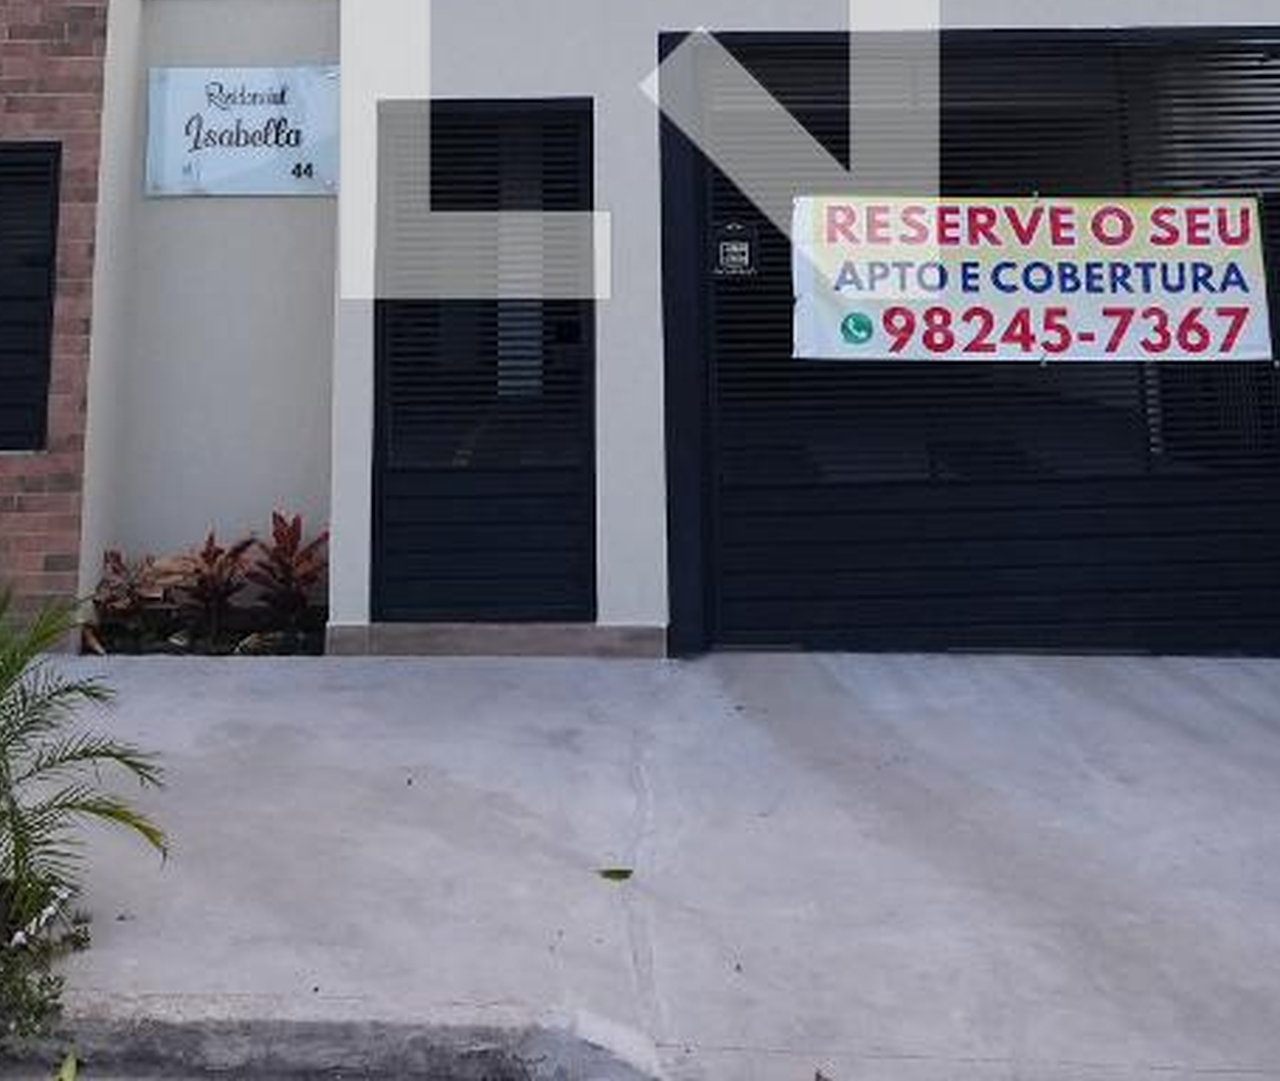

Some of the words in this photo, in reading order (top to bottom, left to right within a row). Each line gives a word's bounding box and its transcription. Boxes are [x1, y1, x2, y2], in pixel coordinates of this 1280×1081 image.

[184, 113, 302, 153] Isabella
[291, 162, 314, 179] 44
[826, 205, 1077, 247] RESERVE
[1090, 206, 1136, 246] O
[1149, 207, 1252, 246] SEU
[834, 261, 948, 293] APTO
[961, 262, 981, 293] E
[990, 261, 1251, 294] COBERTURA
[881, 306, 1251, 354] 98245-7367
